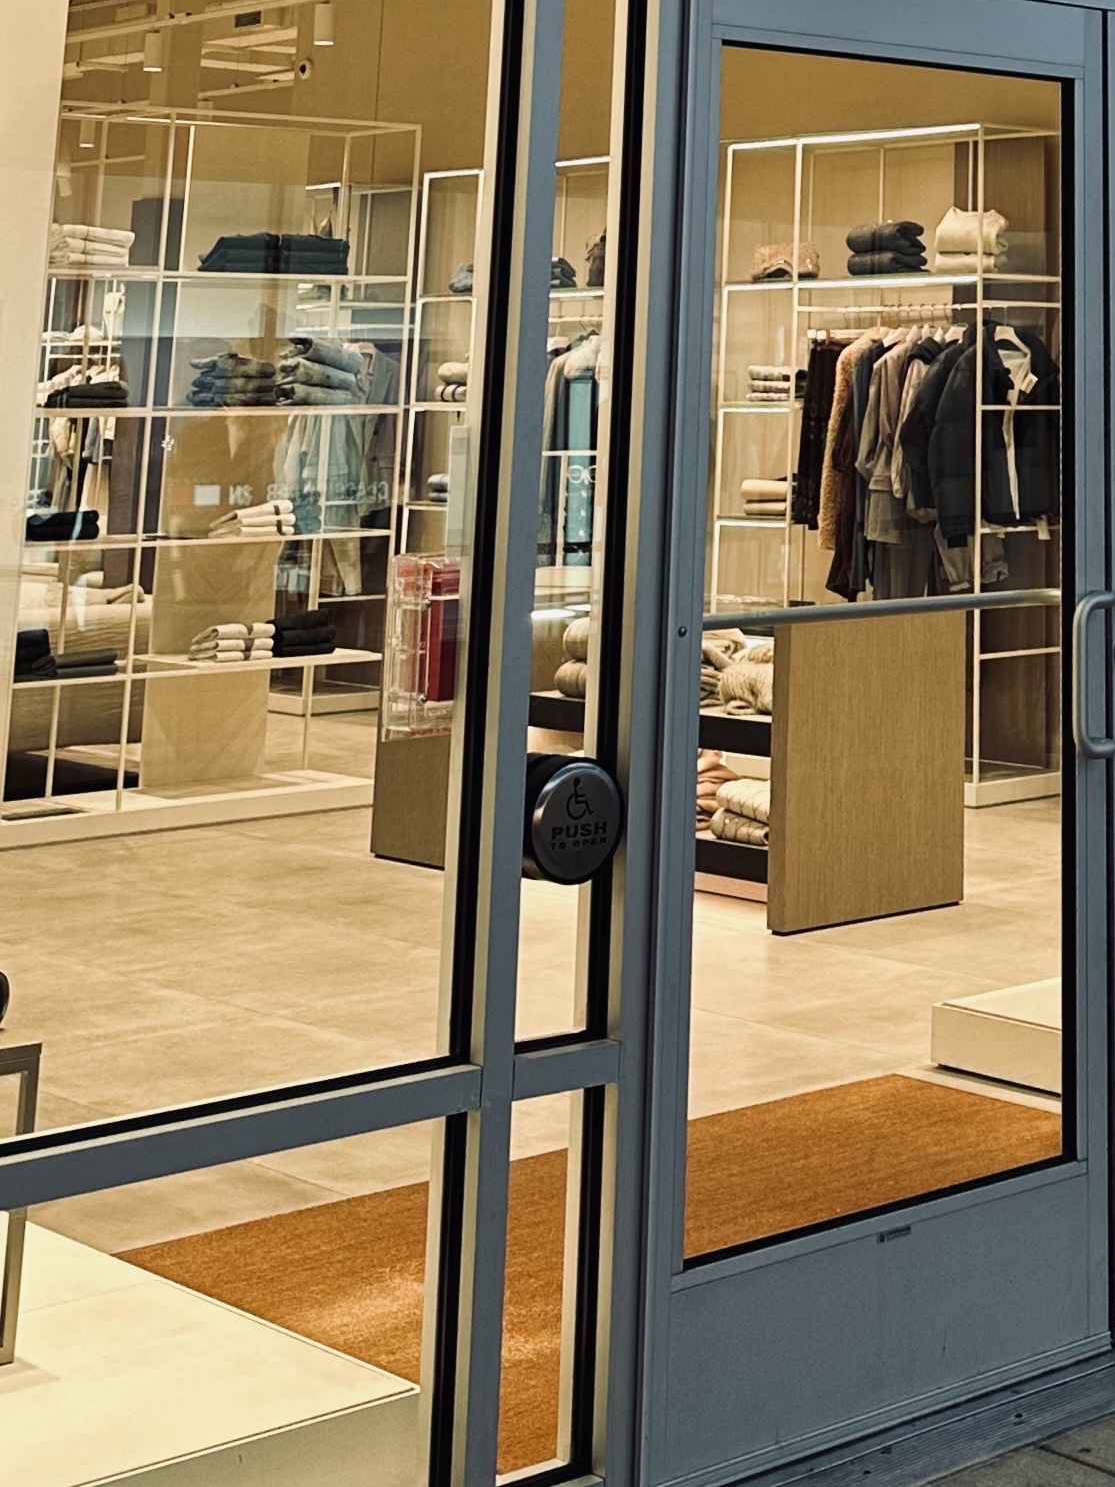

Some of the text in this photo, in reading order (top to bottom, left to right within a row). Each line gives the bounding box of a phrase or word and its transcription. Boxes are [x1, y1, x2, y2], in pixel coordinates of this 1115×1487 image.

[551, 820, 608, 841] PUSH
[550, 836, 607, 851] TO OPEN
